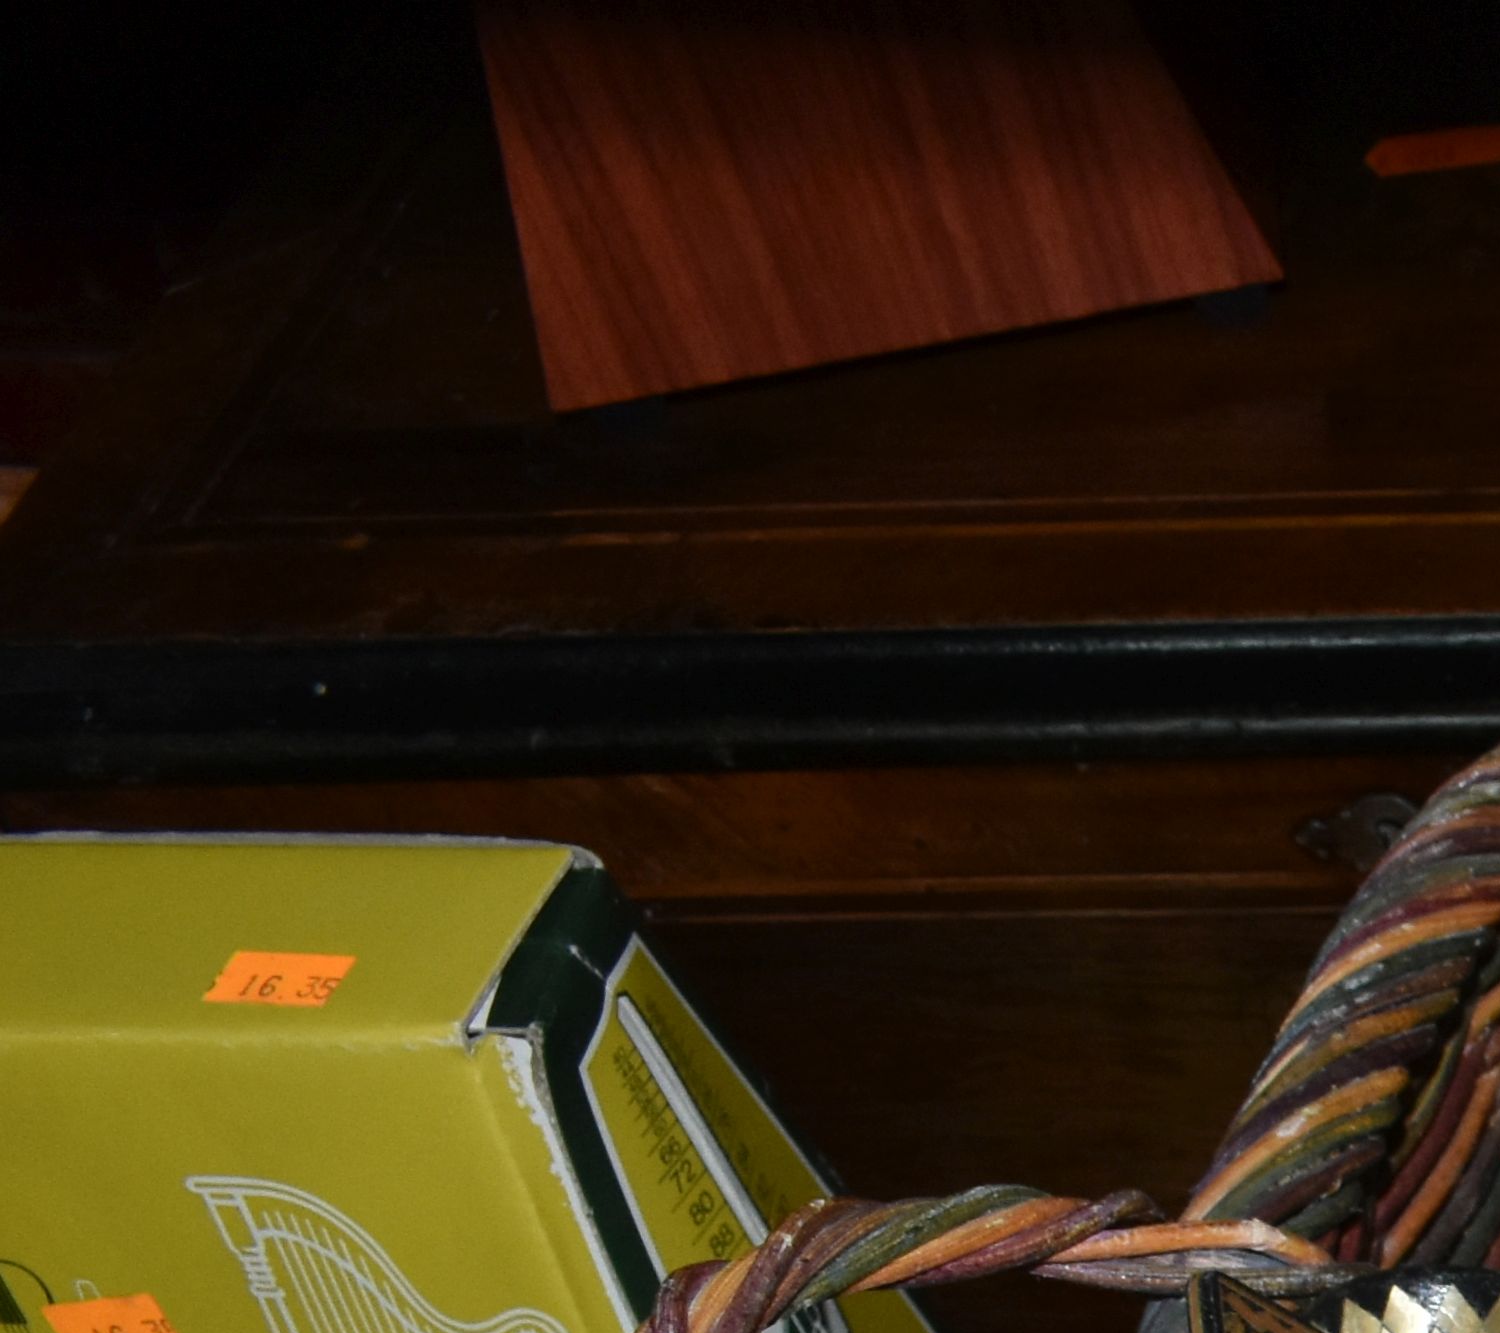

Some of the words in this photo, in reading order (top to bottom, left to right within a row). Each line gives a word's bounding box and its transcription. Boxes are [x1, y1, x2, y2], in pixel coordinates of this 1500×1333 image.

[659, 1136, 683, 1165] 66
[670, 1159, 697, 1194] 72
[689, 1192, 716, 1226] 80
[709, 1223, 736, 1258] 88
